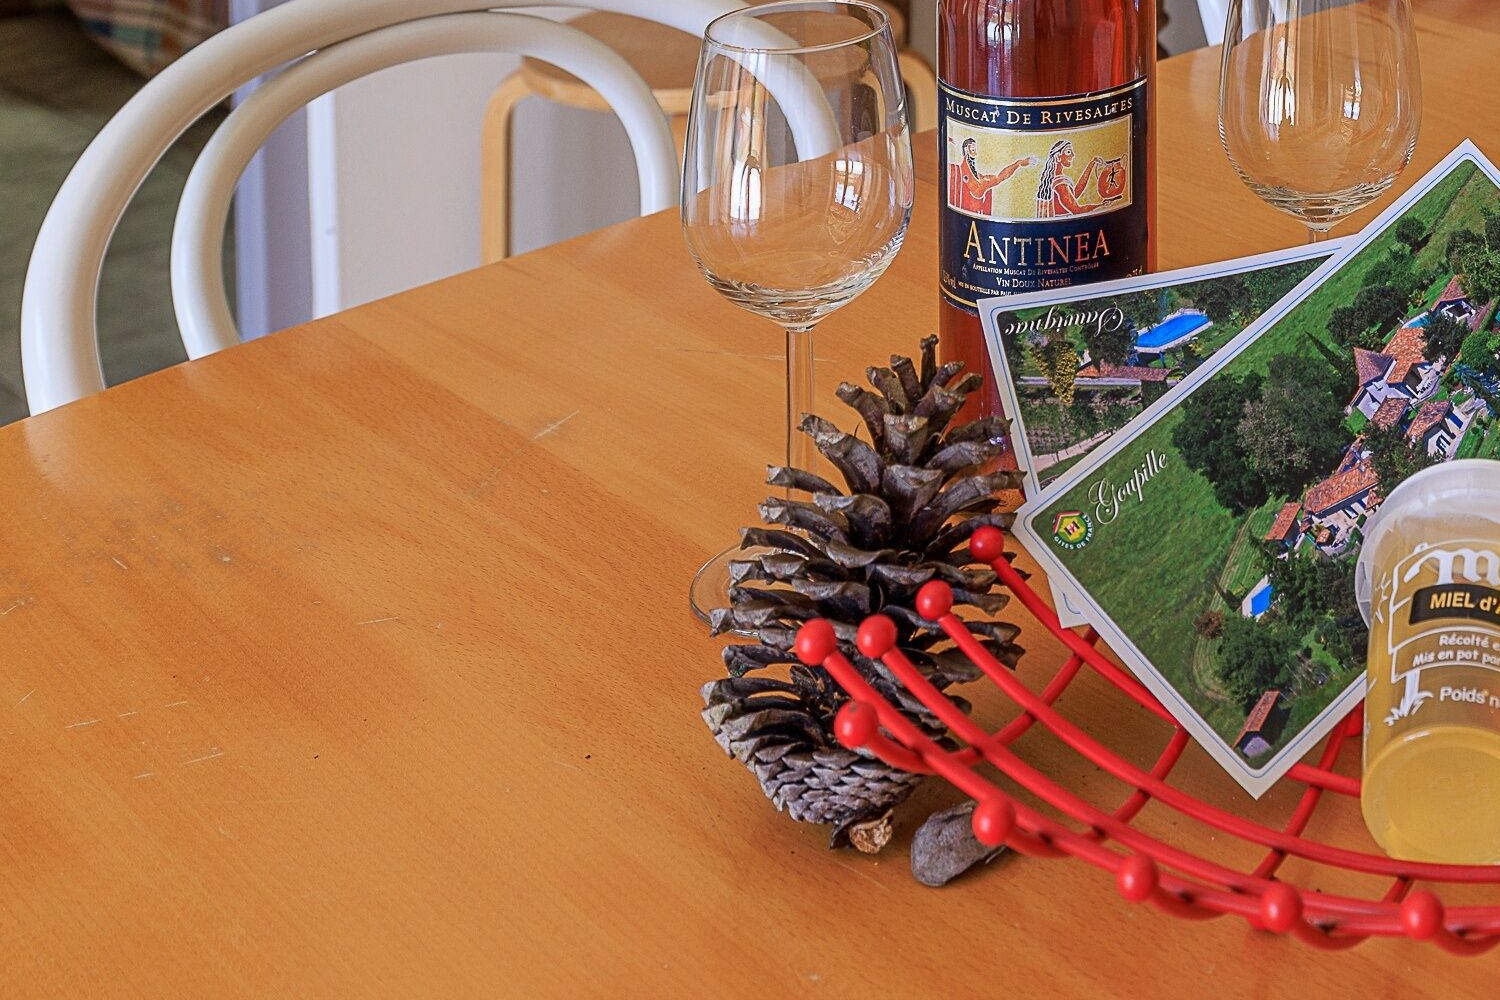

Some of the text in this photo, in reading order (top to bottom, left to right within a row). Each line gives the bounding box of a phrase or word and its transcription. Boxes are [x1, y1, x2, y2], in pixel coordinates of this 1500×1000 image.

[945, 97, 1134, 125] MUSCAT DE RIVESALTES
[963, 220, 1110, 267] ANTINEA
[996, 276, 1073, 288] VIN DOUX NATUREL
[1004, 301, 1124, 338] Sauvignac
[1088, 449, 1168, 525] Goupille
[1429, 591, 1476, 610] MIEL
[1439, 632, 1489, 648] Récolté
[1412, 653, 1435, 668] Mis
[1437, 649, 1455, 661] en
[1456, 649, 1478, 663] pot
[1439, 685, 1485, 705] Poids
